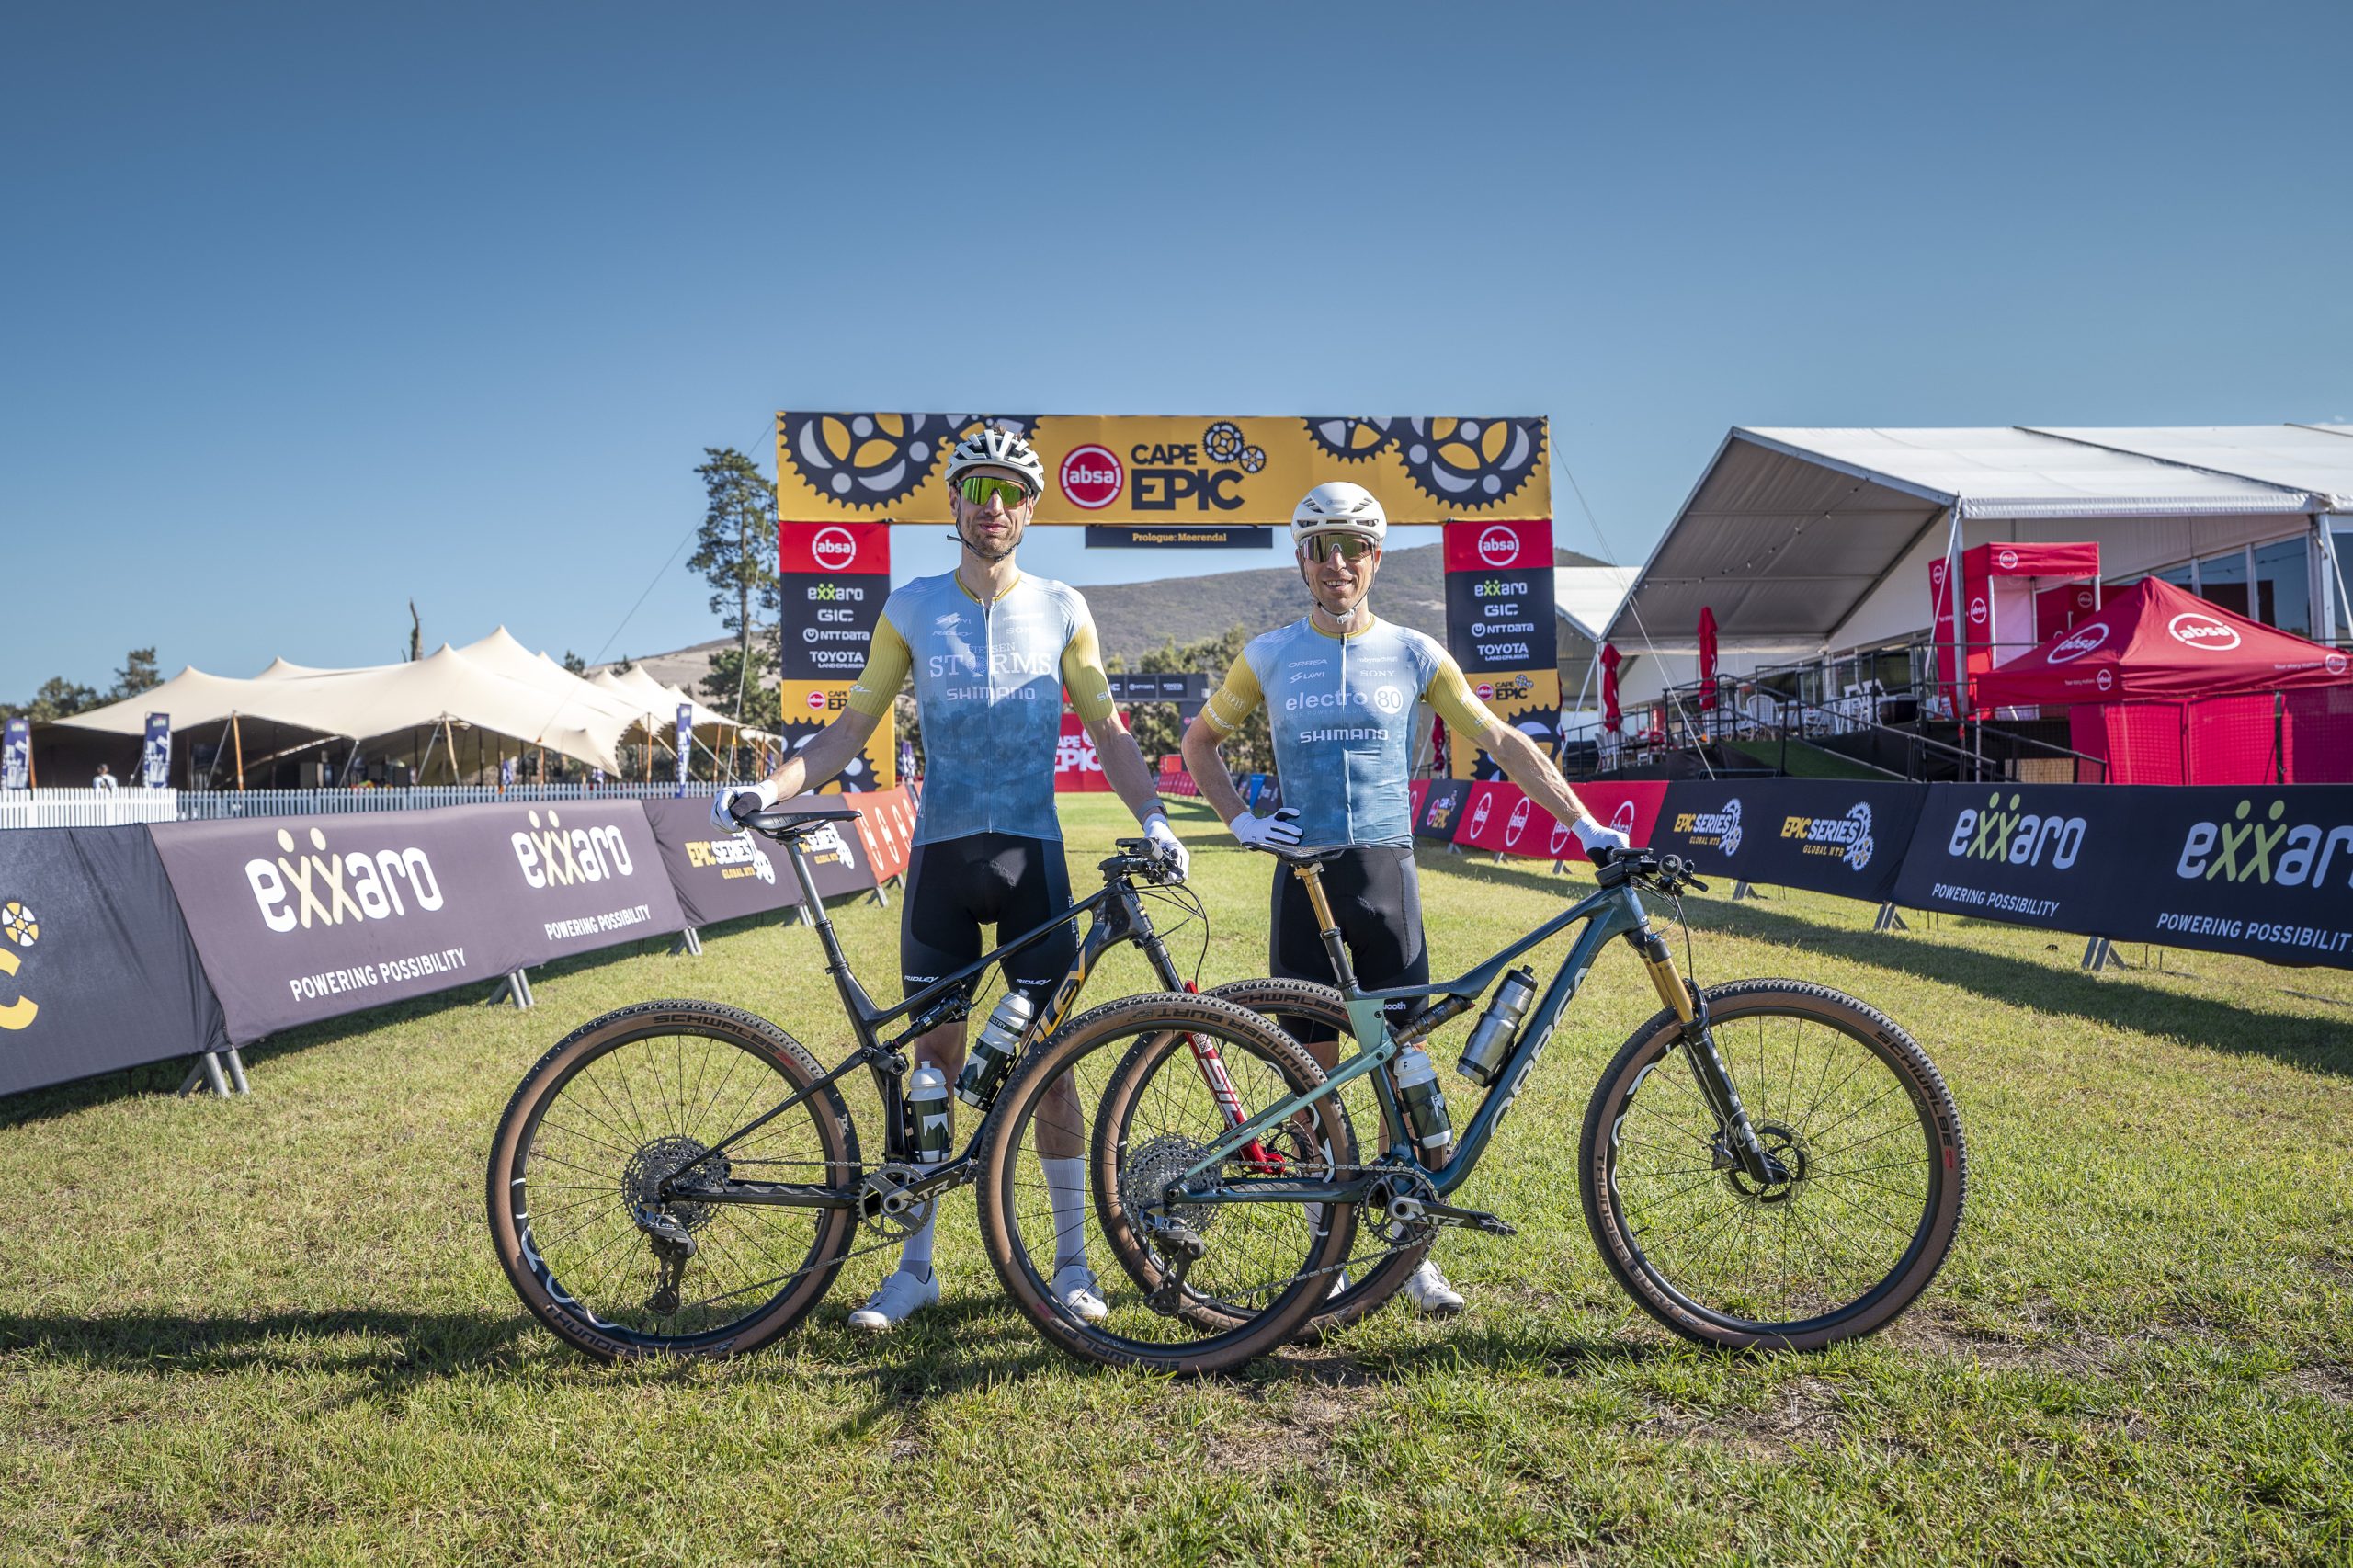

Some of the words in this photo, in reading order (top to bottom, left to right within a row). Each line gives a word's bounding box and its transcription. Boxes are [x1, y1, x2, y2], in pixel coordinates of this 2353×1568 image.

[1131, 443, 1197, 466] CAPE
[1069, 464, 1115, 484] absa
[1131, 469, 1245, 511] EPIC
[1132, 532, 1176, 544] Prologue:
[1178, 531, 1227, 542] Meerendal
[1483, 537, 1516, 551] absa
[817, 539, 851, 553] absa
[807, 583, 864, 601] exxaro
[1474, 579, 1528, 597] exxaro
[817, 608, 854, 622] GIC
[1484, 603, 1518, 617] GIC
[820, 631, 841, 642] NTT
[842, 631, 870, 641] DATA
[1487, 624, 1506, 635] NTT
[1507, 622, 1535, 633] DATA
[2179, 625, 2230, 639] absa
[1476, 642, 1529, 656] TOYOTA
[2060, 635, 2097, 651] absa
[809, 651, 864, 663] TOYOTA
[1288, 658, 1328, 668] ORBEA
[1303, 672, 1324, 680] LAWI
[1360, 669, 1396, 677] SONY
[946, 687, 1036, 700] SHIMANO
[1284, 689, 1369, 711] electro
[1377, 689, 1403, 709] 80
[1495, 687, 1528, 700] EPIC
[1057, 735, 1081, 748] APE
[1300, 728, 1389, 744] SHIMANO
[1510, 811, 1528, 827] absa
[1674, 813, 1696, 833] EPIC
[1693, 814, 1733, 835] SERIES
[1780, 816, 1811, 839] EPIC
[1807, 819, 1860, 844] SERIES
[1948, 791, 2086, 870] exxaro
[511, 810, 633, 889] exxaro
[1802, 845, 1827, 855] GLOBAL
[1828, 846, 1844, 857] MTB
[2177, 800, 2353, 889] exxar
[685, 840, 716, 868] EPIC
[244, 827, 444, 933] exxaro
[1932, 882, 1986, 906] POWERING
[1987, 892, 2061, 917] POSSIBILITY
[544, 917, 598, 941] POWERING
[598, 904, 651, 932] POSSIBILITY
[2156, 912, 2242, 940] POWERING
[2245, 923, 2353, 952] POSSIBILIT
[290, 965, 379, 1002] POWERING
[380, 948, 467, 984] POSSIBILITY
[904, 974, 939, 983] RIDLEY
[1016, 978, 1052, 986] RIDLEY
[654, 1014, 779, 1054] SCHWALBE
[1875, 1030, 1953, 1147] SCHWALBE
[1413, 1210, 1465, 1228] XTR
[1597, 1153, 1632, 1262] THUNDER
[1629, 1264, 1680, 1312] BURT
